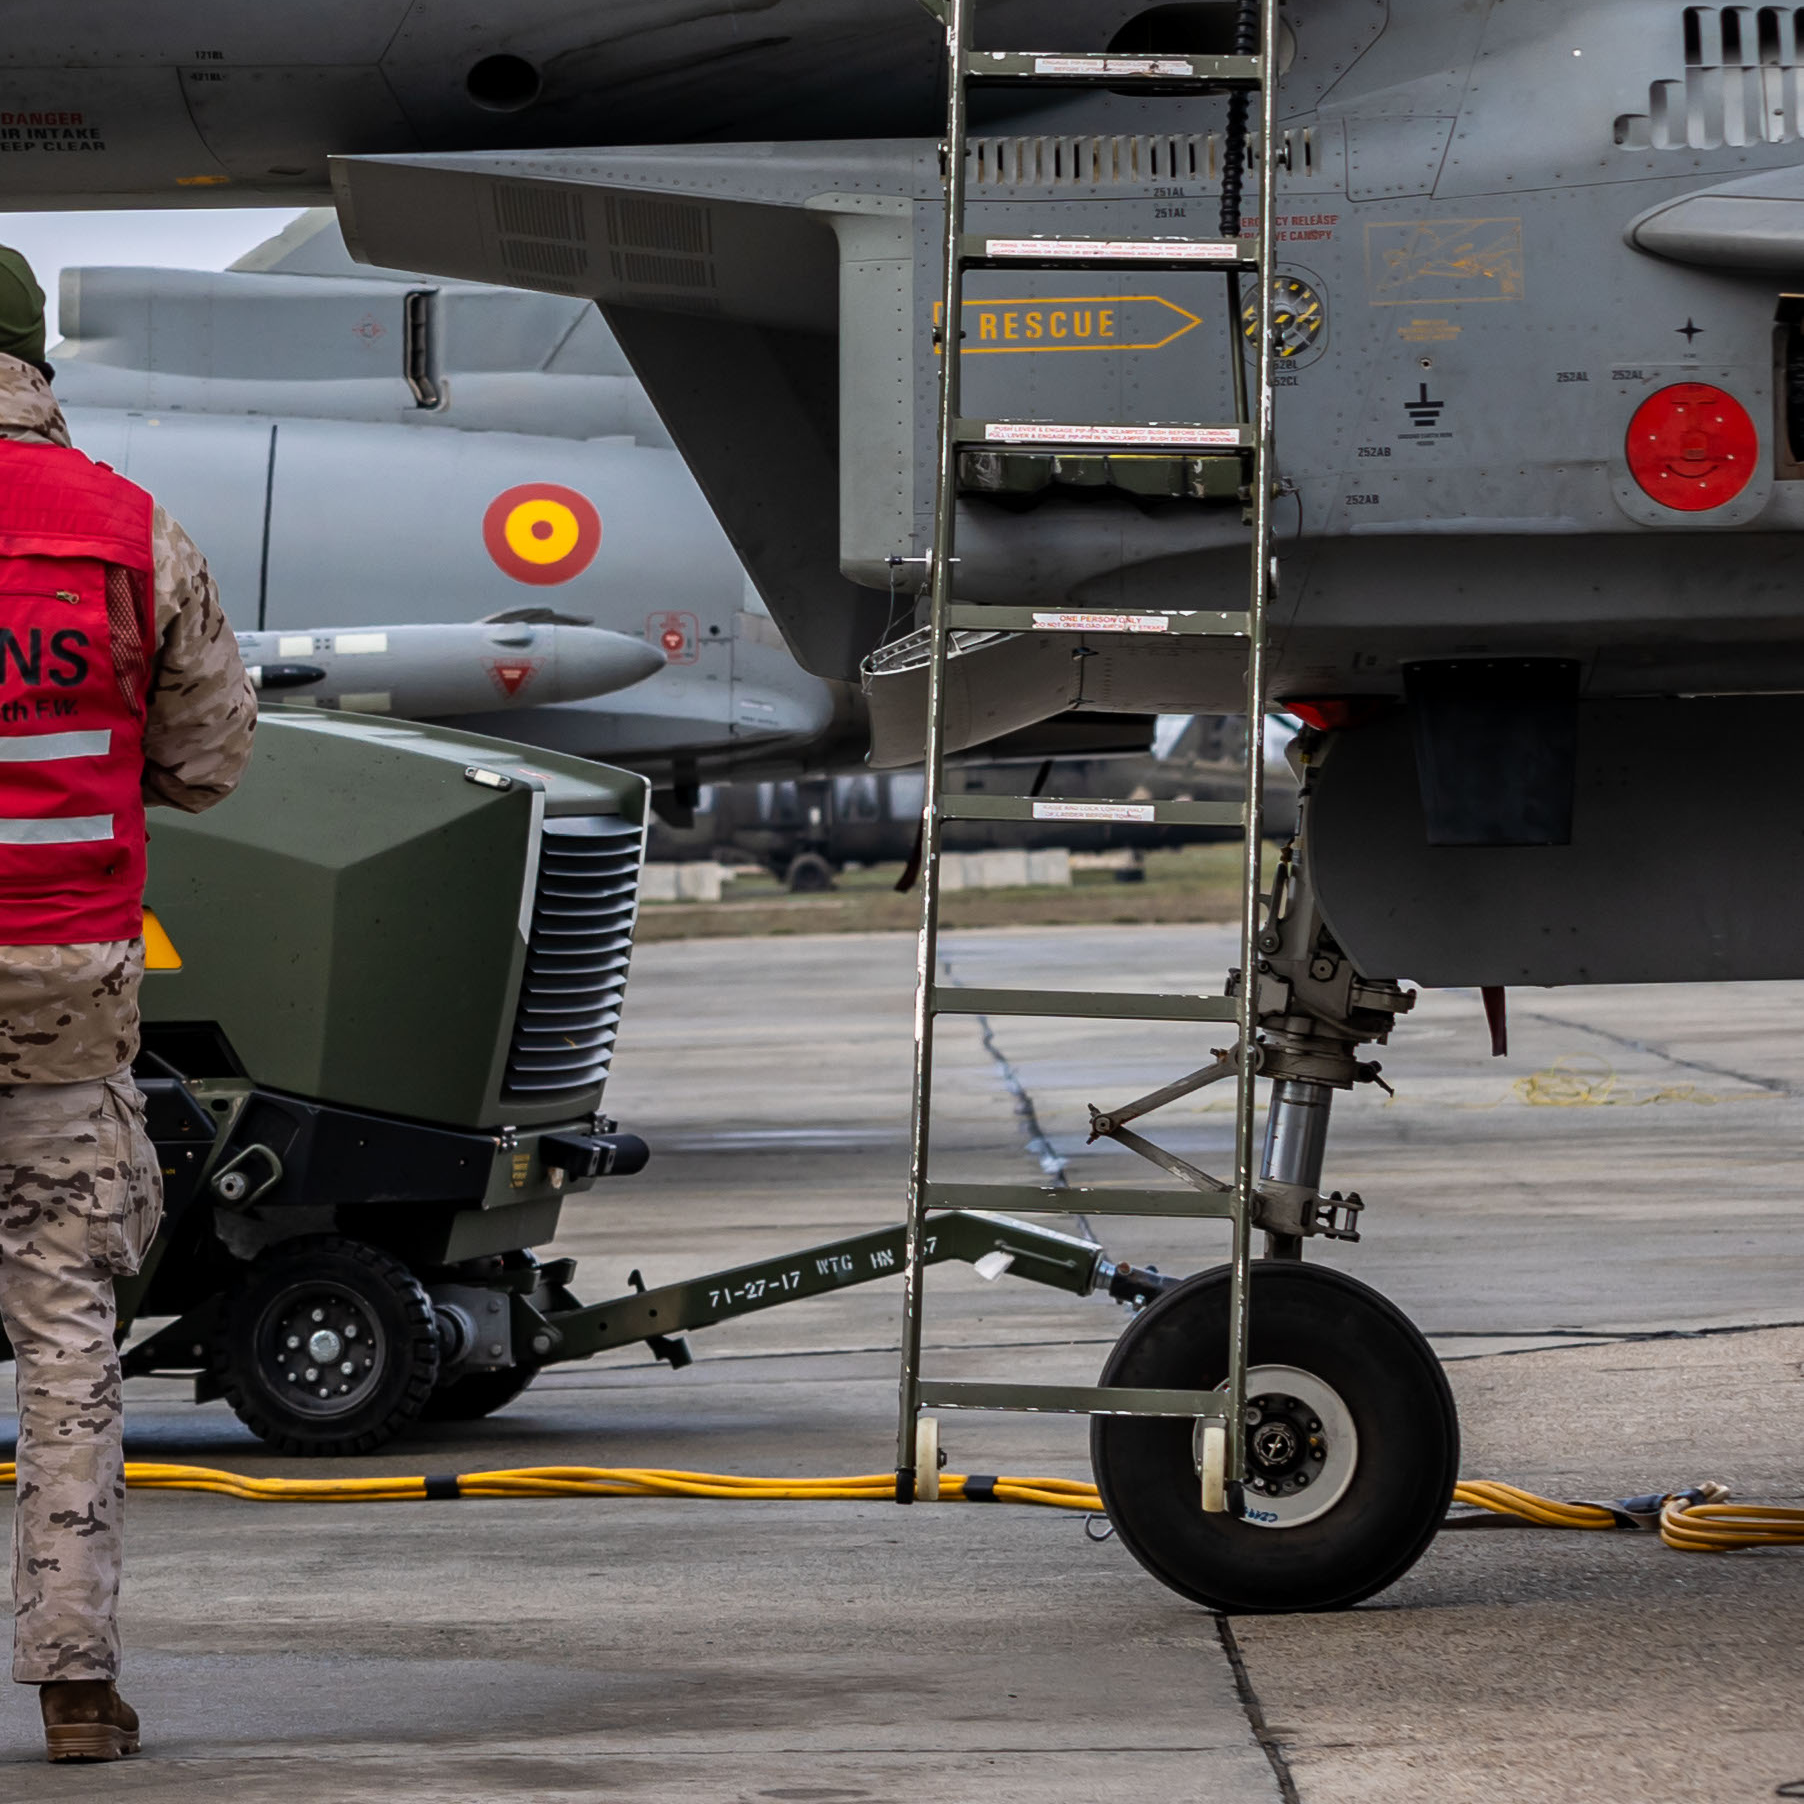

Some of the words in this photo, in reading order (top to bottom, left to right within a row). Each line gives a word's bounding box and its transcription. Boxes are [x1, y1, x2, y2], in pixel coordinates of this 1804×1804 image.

[1, 112, 84, 126] DANGER
[27, 128, 101, 140] INTAKE
[42, 141, 106, 152] CLEAR
[1153, 187, 1185, 197] 251AL
[1154, 208, 1187, 218] 251AL
[1292, 215, 1338, 226] RELEASE
[979, 310, 1115, 340] RESCUE
[1273, 359, 1298, 370] 52BL
[1556, 371, 1589, 382] 252AL
[1612, 369, 1644, 381] 252AL
[1273, 376, 1299, 386] 52CL
[1357, 447, 1391, 457] 252AB
[1345, 495, 1380, 505] 252AB
[1118, 616, 1142, 624] ONLY
[35, 699, 80, 720] F.W.
[709, 1271, 801, 1308] 71-27-17
[870, 1249, 895, 1269] HN
